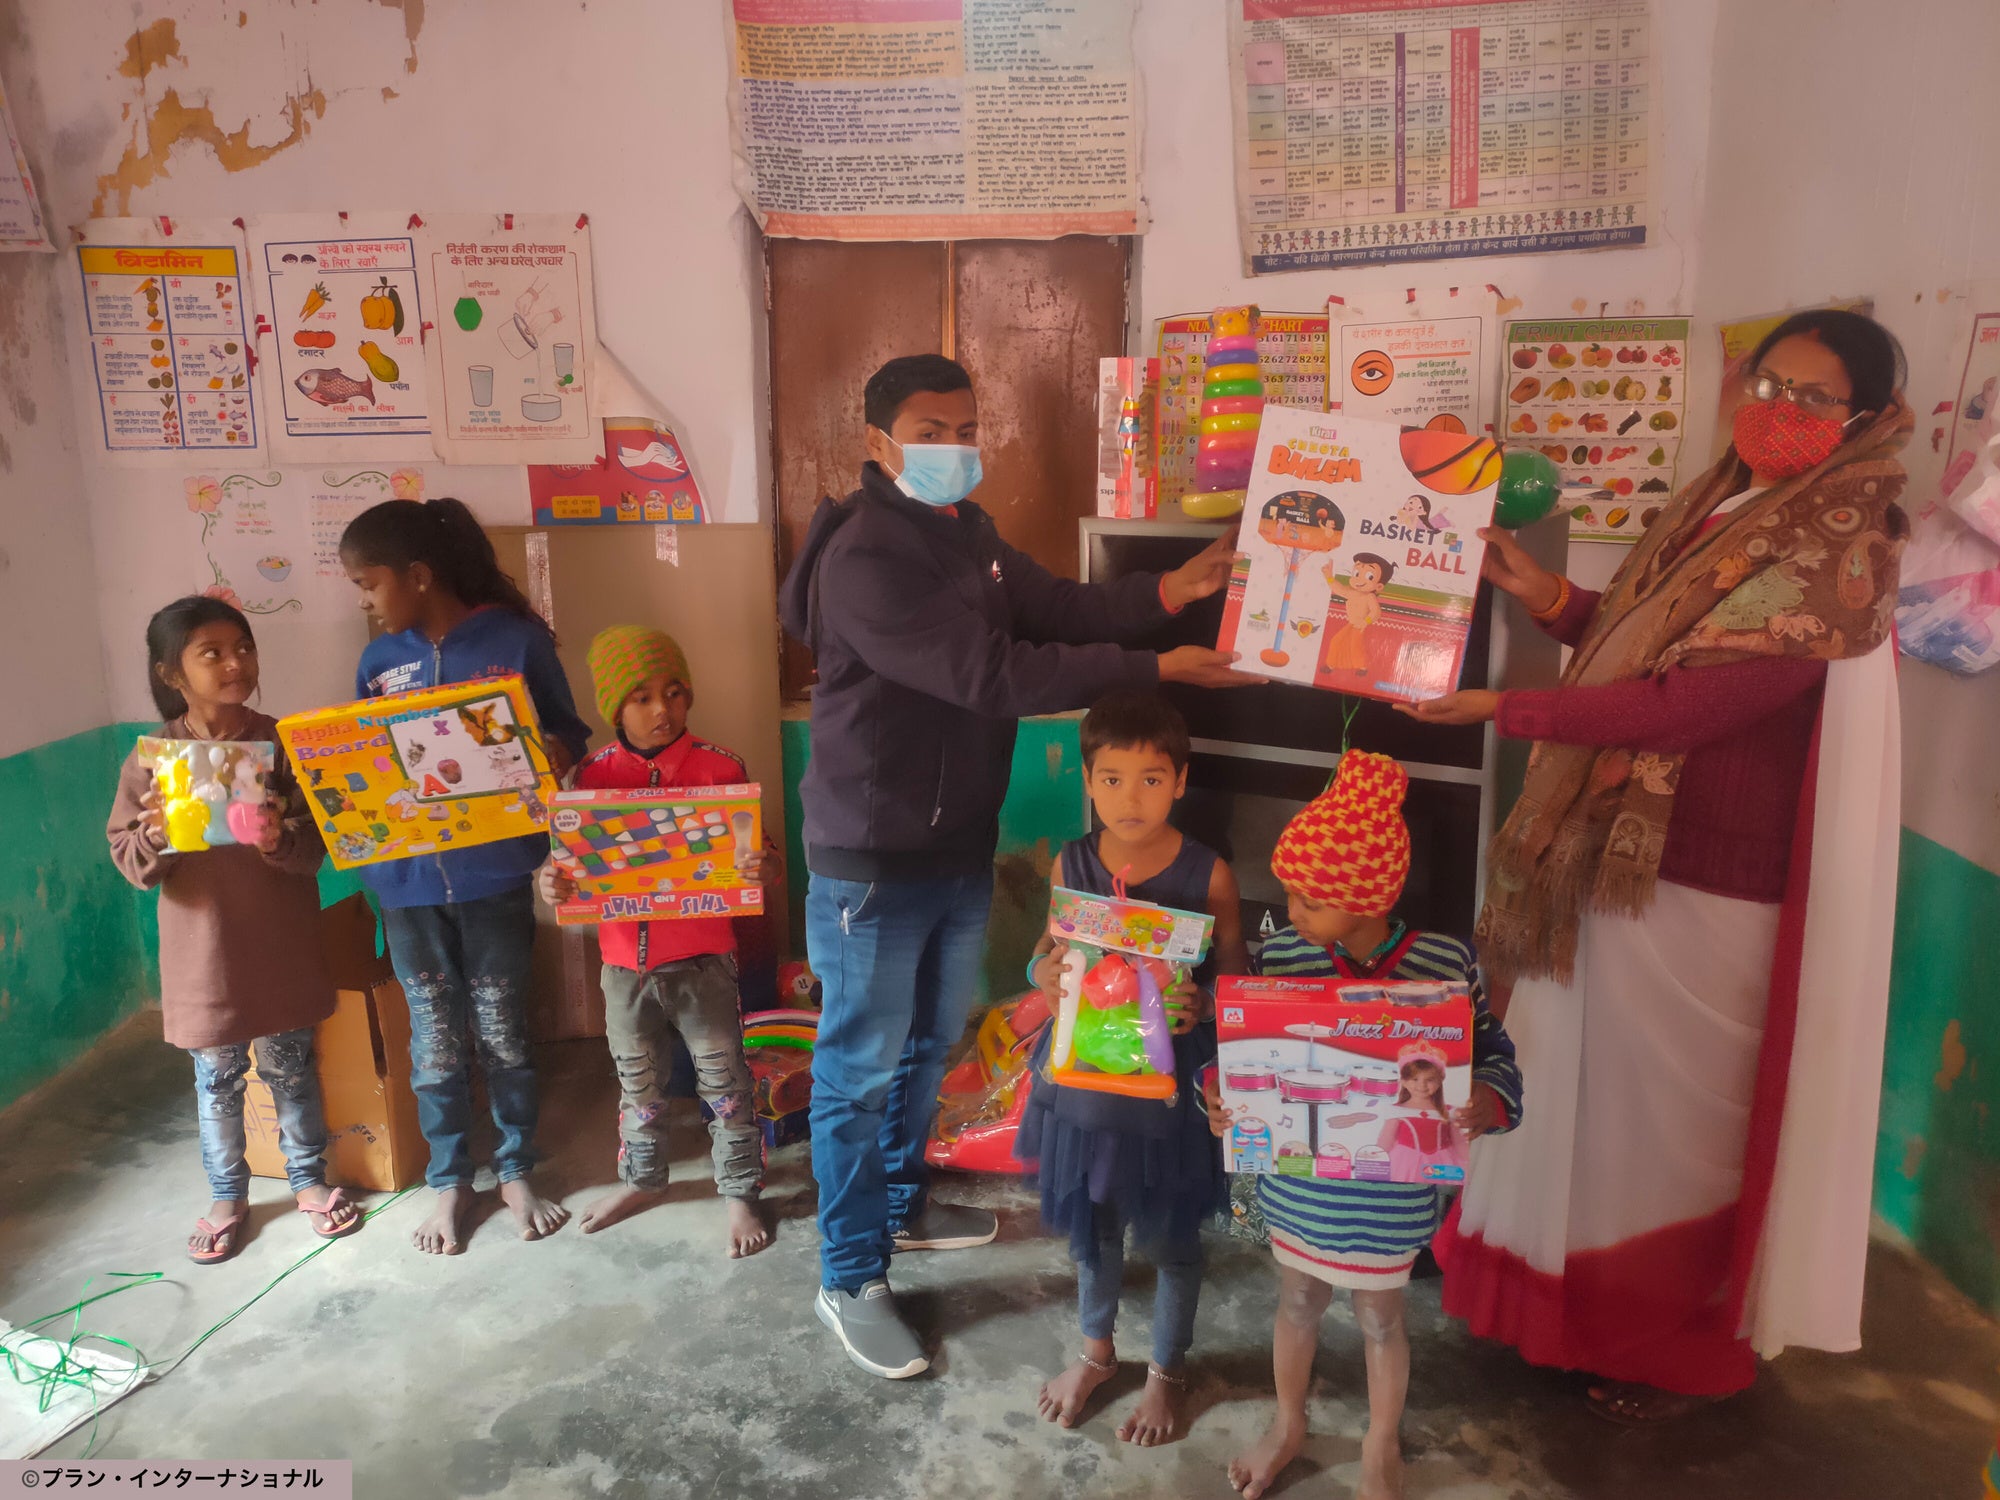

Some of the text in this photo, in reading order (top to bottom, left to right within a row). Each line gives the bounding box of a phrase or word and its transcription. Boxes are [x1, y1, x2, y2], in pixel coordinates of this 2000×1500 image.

[342, 243, 354, 254] को
[446, 242, 566, 255] निर्जली करण की रोकथाम
[1293, 255, 1307, 265] यदि
[1310, 253, 1330, 264] किसी
[1389, 247, 1408, 257] समय
[1410, 244, 1442, 255] परिवर्तित
[1443, 243, 1461, 253] होता
[1471, 241, 1480, 251] तो
[1502, 237, 1518, 249] कार्य
[1521, 236, 1537, 247] उसी
[1539, 236, 1549, 246] के
[114, 249, 206, 269] विटामिन
[319, 257, 329, 269] के
[332, 256, 351, 269] लिए
[451, 255, 462, 266] के
[464, 254, 483, 266] लिए
[487, 256, 509, 266] अन्य
[535, 256, 563, 266] उपचार
[1187, 319, 1305, 332] NUM CHART
[1513, 323, 1659, 341] FRUIT CHART
[395, 336, 414, 346] आम
[1191, 334, 1198, 343] 1
[1272, 334, 1284, 342] 61
[1286, 333, 1298, 342] 71
[1300, 333, 1312, 342] 81
[1314, 333, 1326, 342] 91
[297, 349, 325, 360] टमाटर
[1191, 356, 1198, 364] 2
[1271, 356, 1284, 364] 62
[1285, 356, 1298, 364] 72
[1299, 355, 1312, 363] 82
[1313, 355, 1326, 363] 92
[389, 380, 410, 391] पपीता
[1190, 375, 1326, 384] 3 63 73 83 93
[1190, 396, 1196, 405] 4
[1284, 395, 1297, 404] 74
[1297, 395, 1311, 404] 84
[1311, 395, 1324, 404] 94
[358, 404, 369, 413] का
[1191, 417, 1197, 425] 5
[1189, 437, 1196, 445] 6
[1288, 438, 1349, 458] CHHOTA
[1267, 445, 1362, 484] BHEEM
[1360, 519, 1435, 545] BASKET
[1405, 547, 1466, 575] BALL
[400, 660, 422, 675] STYLE
[291, 707, 442, 744] Alpha Number
[432, 720, 451, 736] X
[295, 733, 391, 761] Board
[423, 774, 451, 796] A
[654, 893, 676, 904] AND
[680, 893, 730, 915] THIS
[602, 896, 653, 920] THAT
[1273, 980, 1325, 992] Drum
[1329, 1018, 1464, 1041] Jazz Drum
